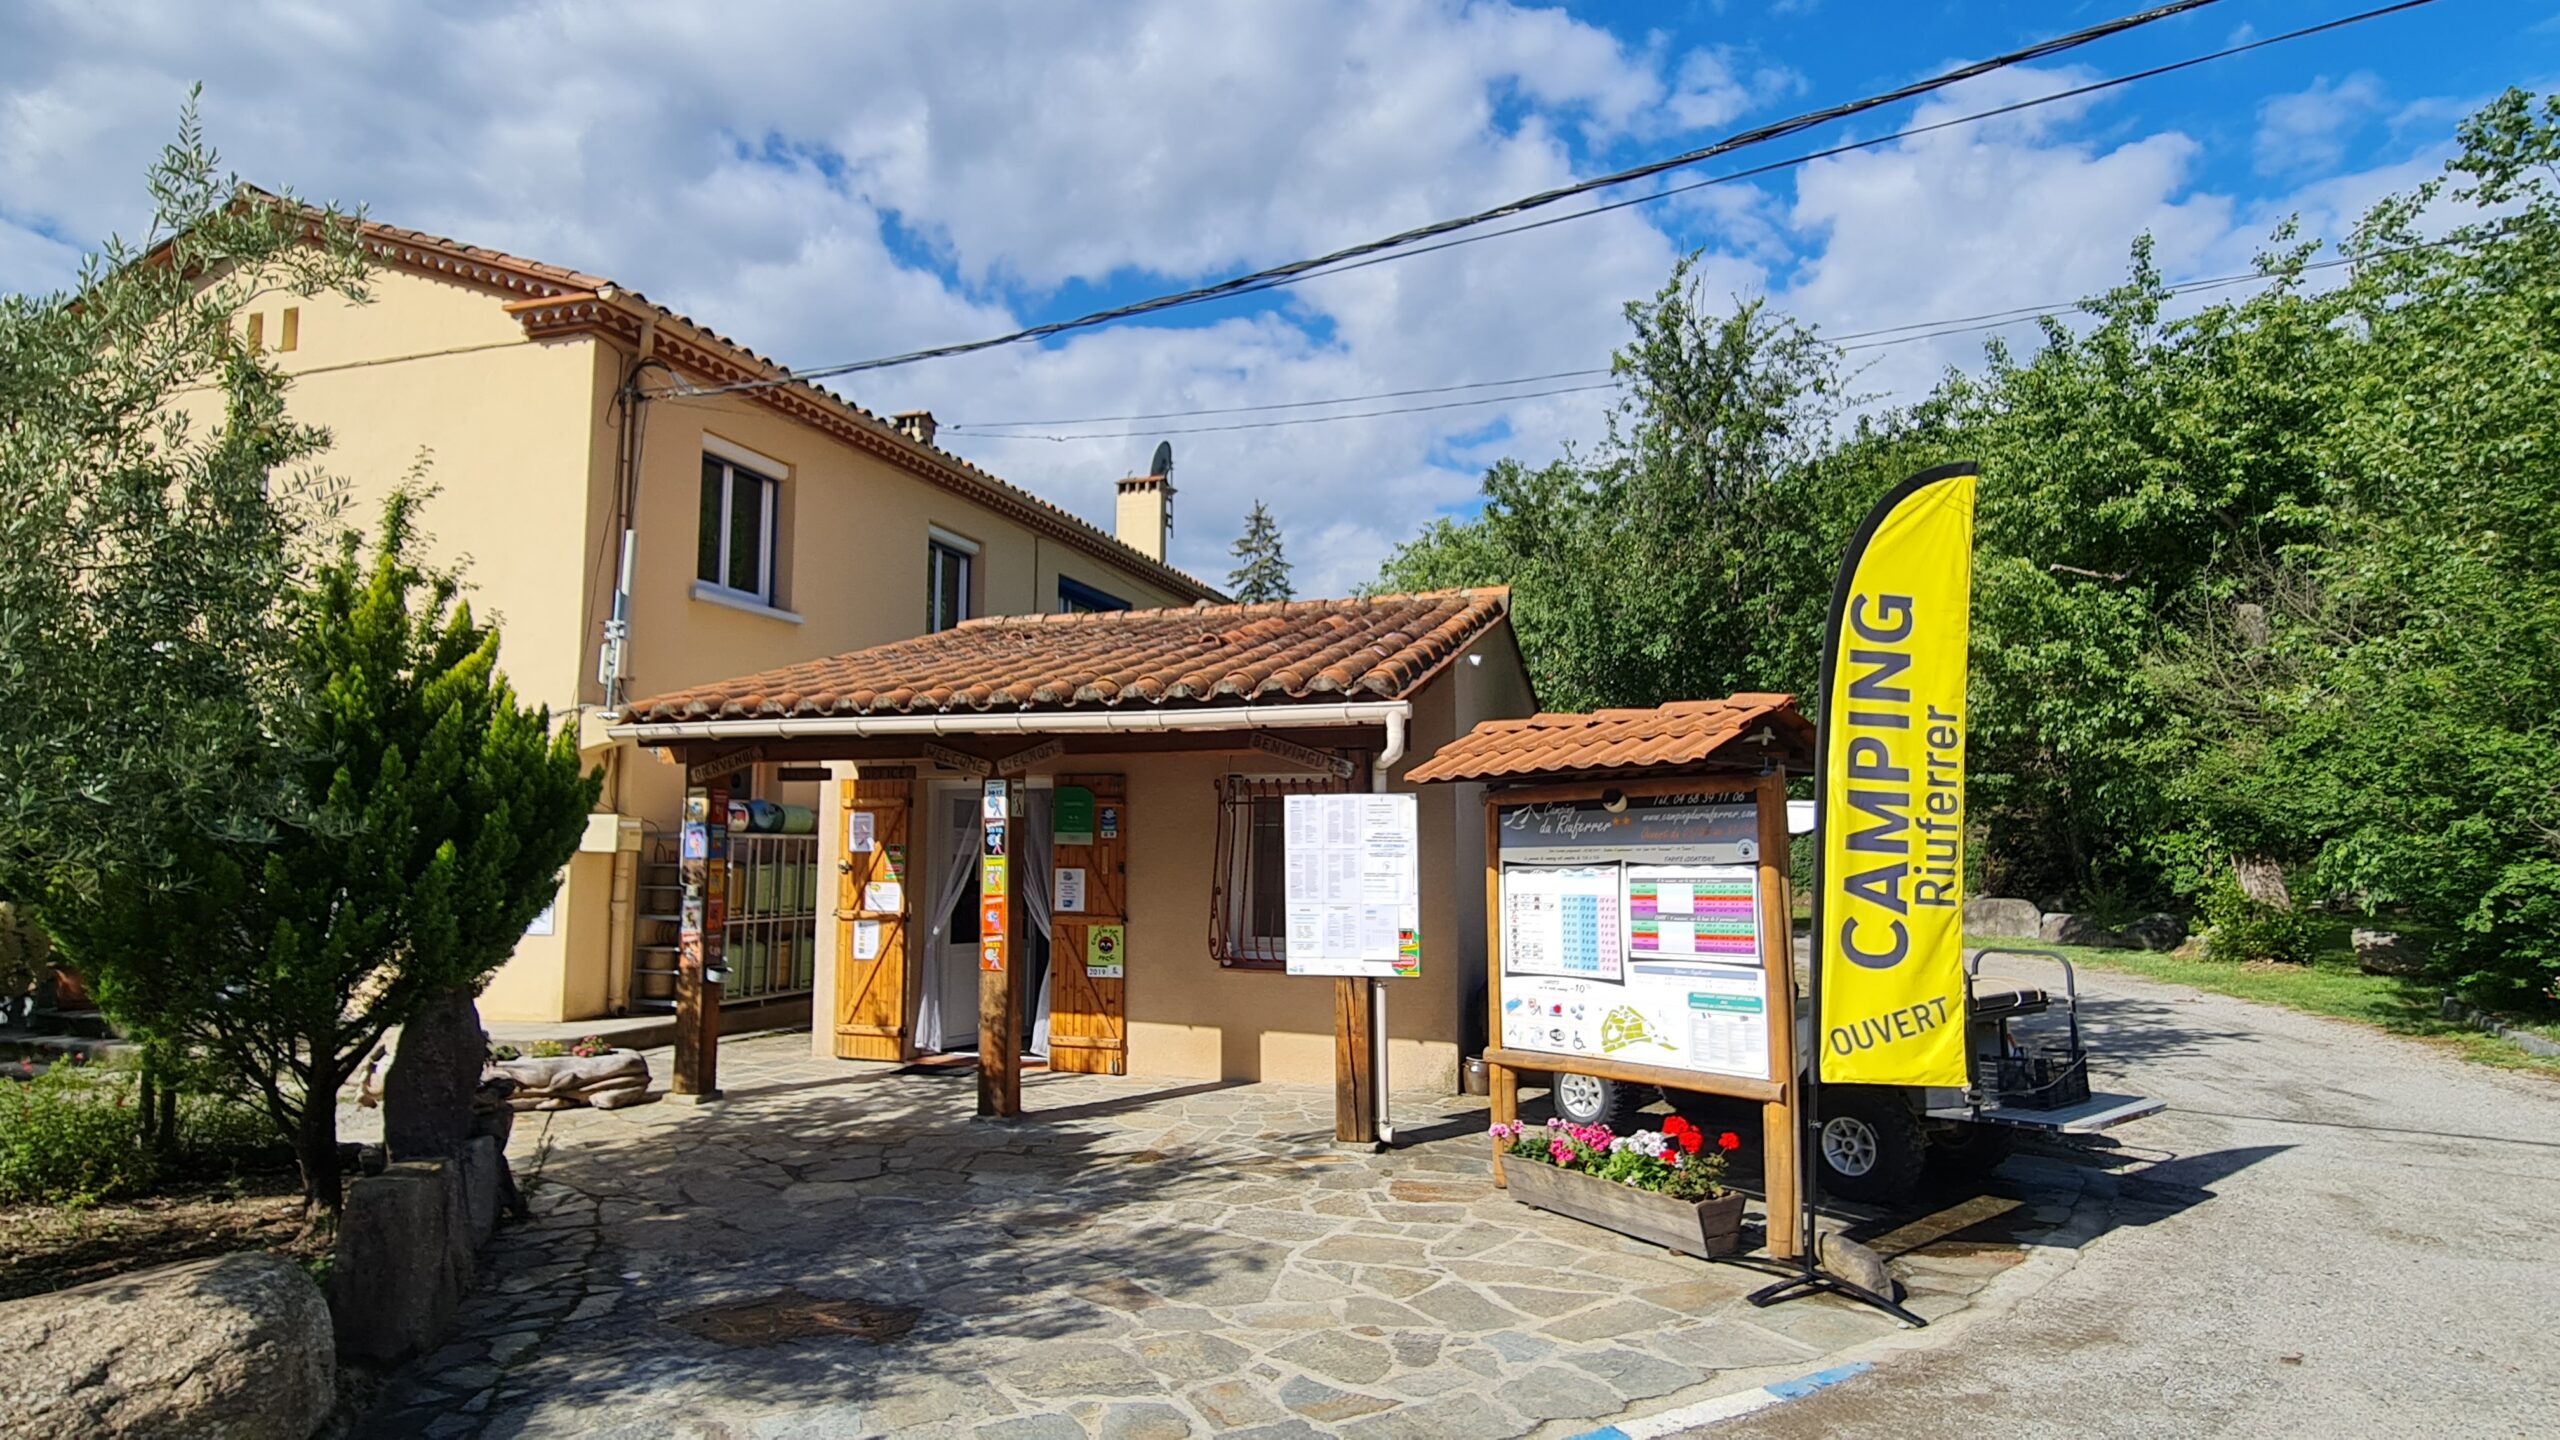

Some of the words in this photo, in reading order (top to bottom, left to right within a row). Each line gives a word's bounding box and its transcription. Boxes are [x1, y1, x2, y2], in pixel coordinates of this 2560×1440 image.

[927, 744, 988, 774] WELCOME
[1840, 592, 1913, 970] CAMPING
[1543, 802, 1576, 821] Camping
[1687, 794, 1700, 804] 68
[1732, 790, 1745, 802] 06
[1913, 704, 1959, 907] Riuferrer
[1089, 968, 1106, 976] 2019
[1830, 996, 1947, 1056] OUVERT
